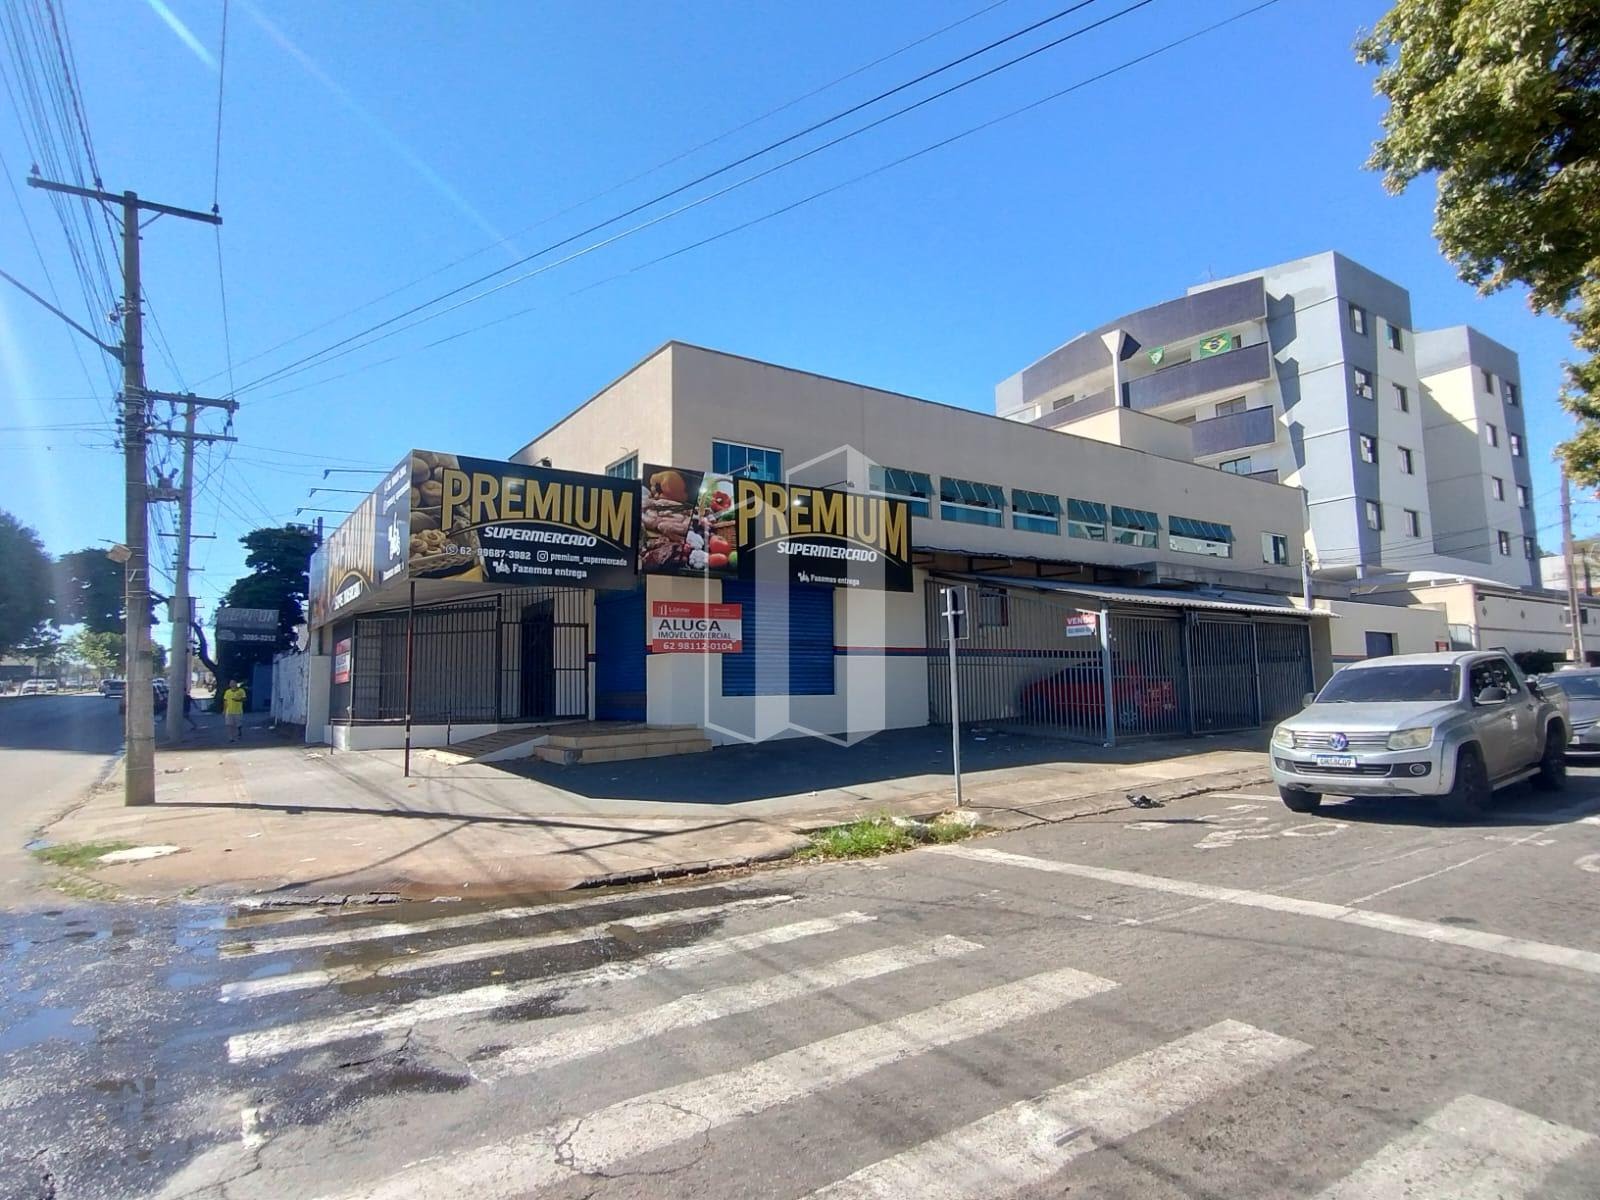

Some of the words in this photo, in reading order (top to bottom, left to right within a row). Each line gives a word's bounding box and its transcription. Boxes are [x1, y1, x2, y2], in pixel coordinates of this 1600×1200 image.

[442, 469, 632, 547] PREMIUM
[738, 480, 908, 562] PREMIUM
[484, 526, 597, 547] SUPERMERCADO
[777, 541, 877, 563] SUPERMERCADO
[512, 563, 553, 576] Fazemos
[555, 568, 588, 580] entrega
[659, 619, 721, 632] ALUGA
[690, 631, 731, 639] COMERCIAL
[663, 642, 675, 650] 62
[678, 642, 733, 651] 98112-0104
